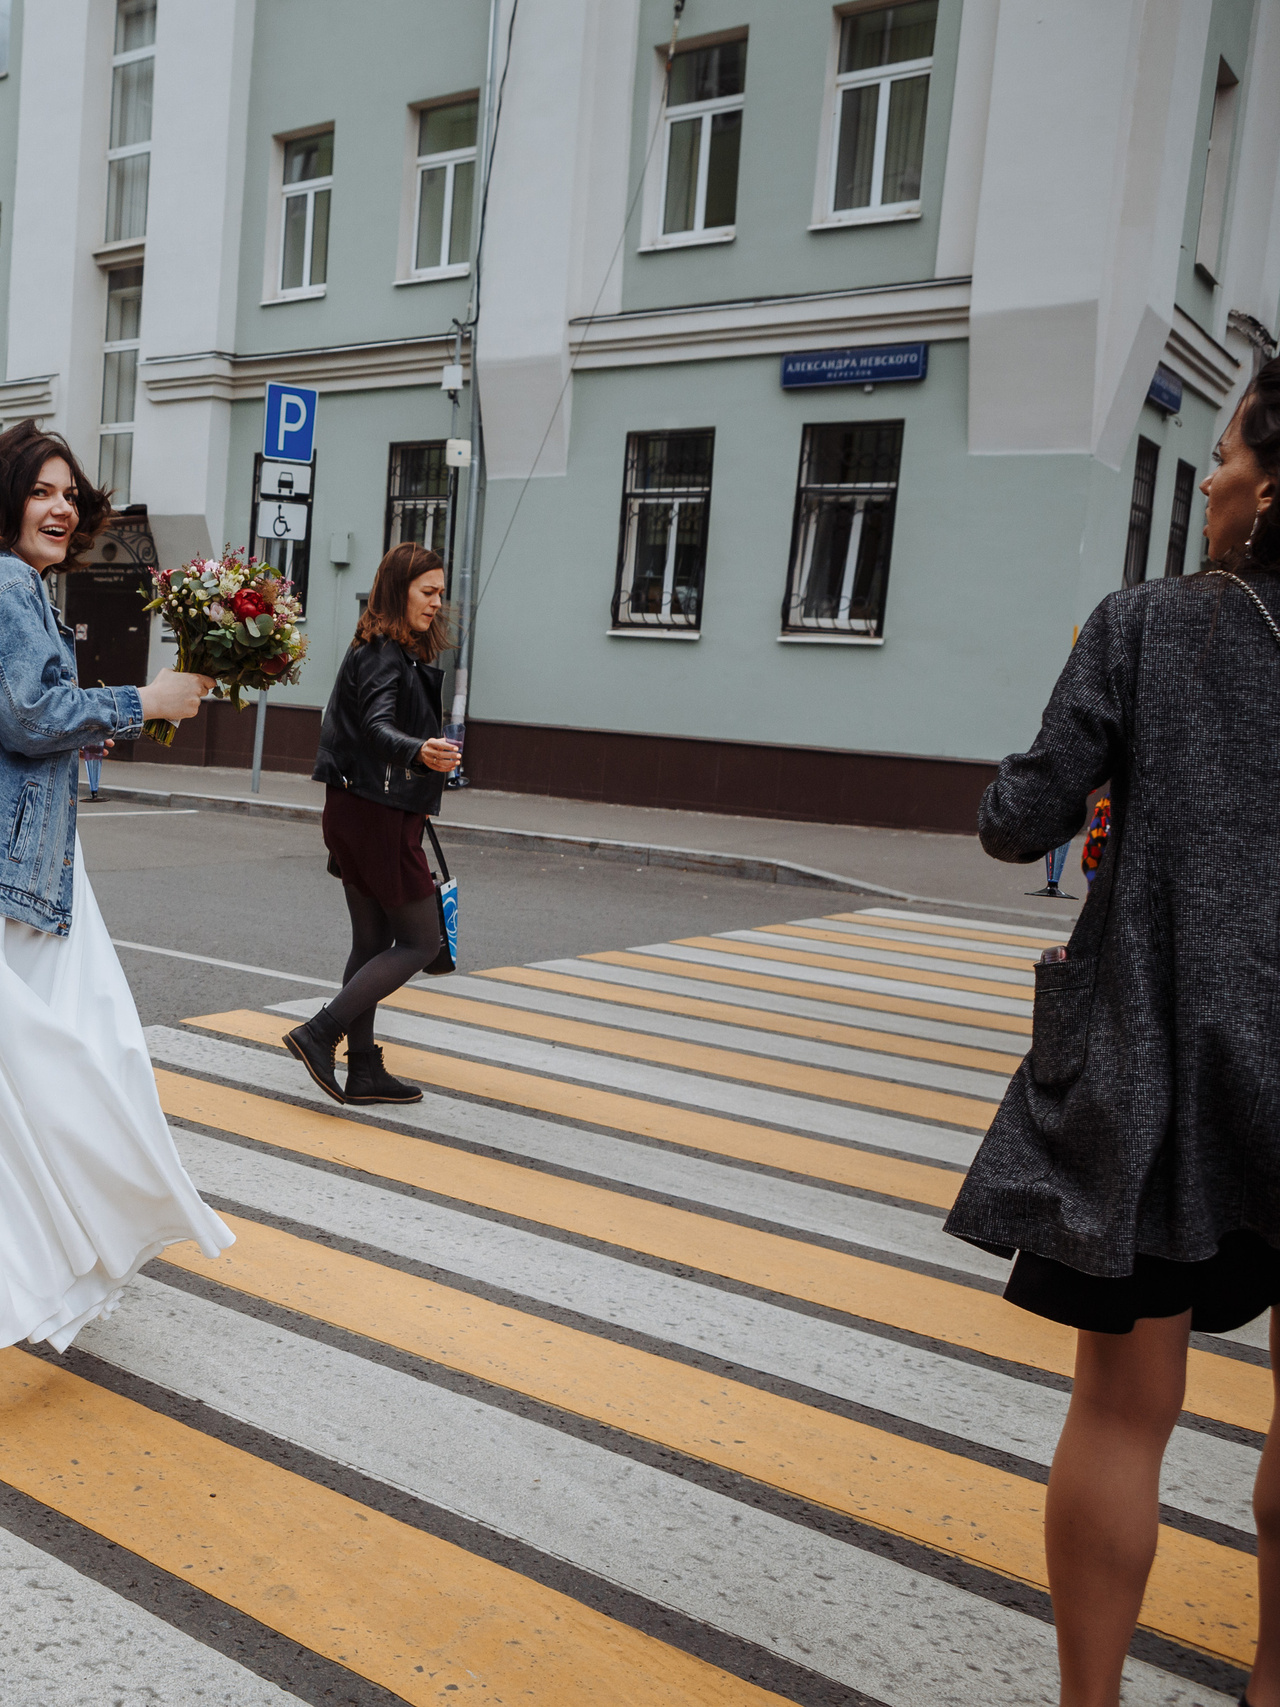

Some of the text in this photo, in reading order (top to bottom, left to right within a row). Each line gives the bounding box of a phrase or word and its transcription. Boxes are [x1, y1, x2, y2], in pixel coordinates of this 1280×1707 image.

[786, 352, 918, 373] АЛЕКСАНДРА НЕВСКОГО
[277, 393, 307, 451] P
